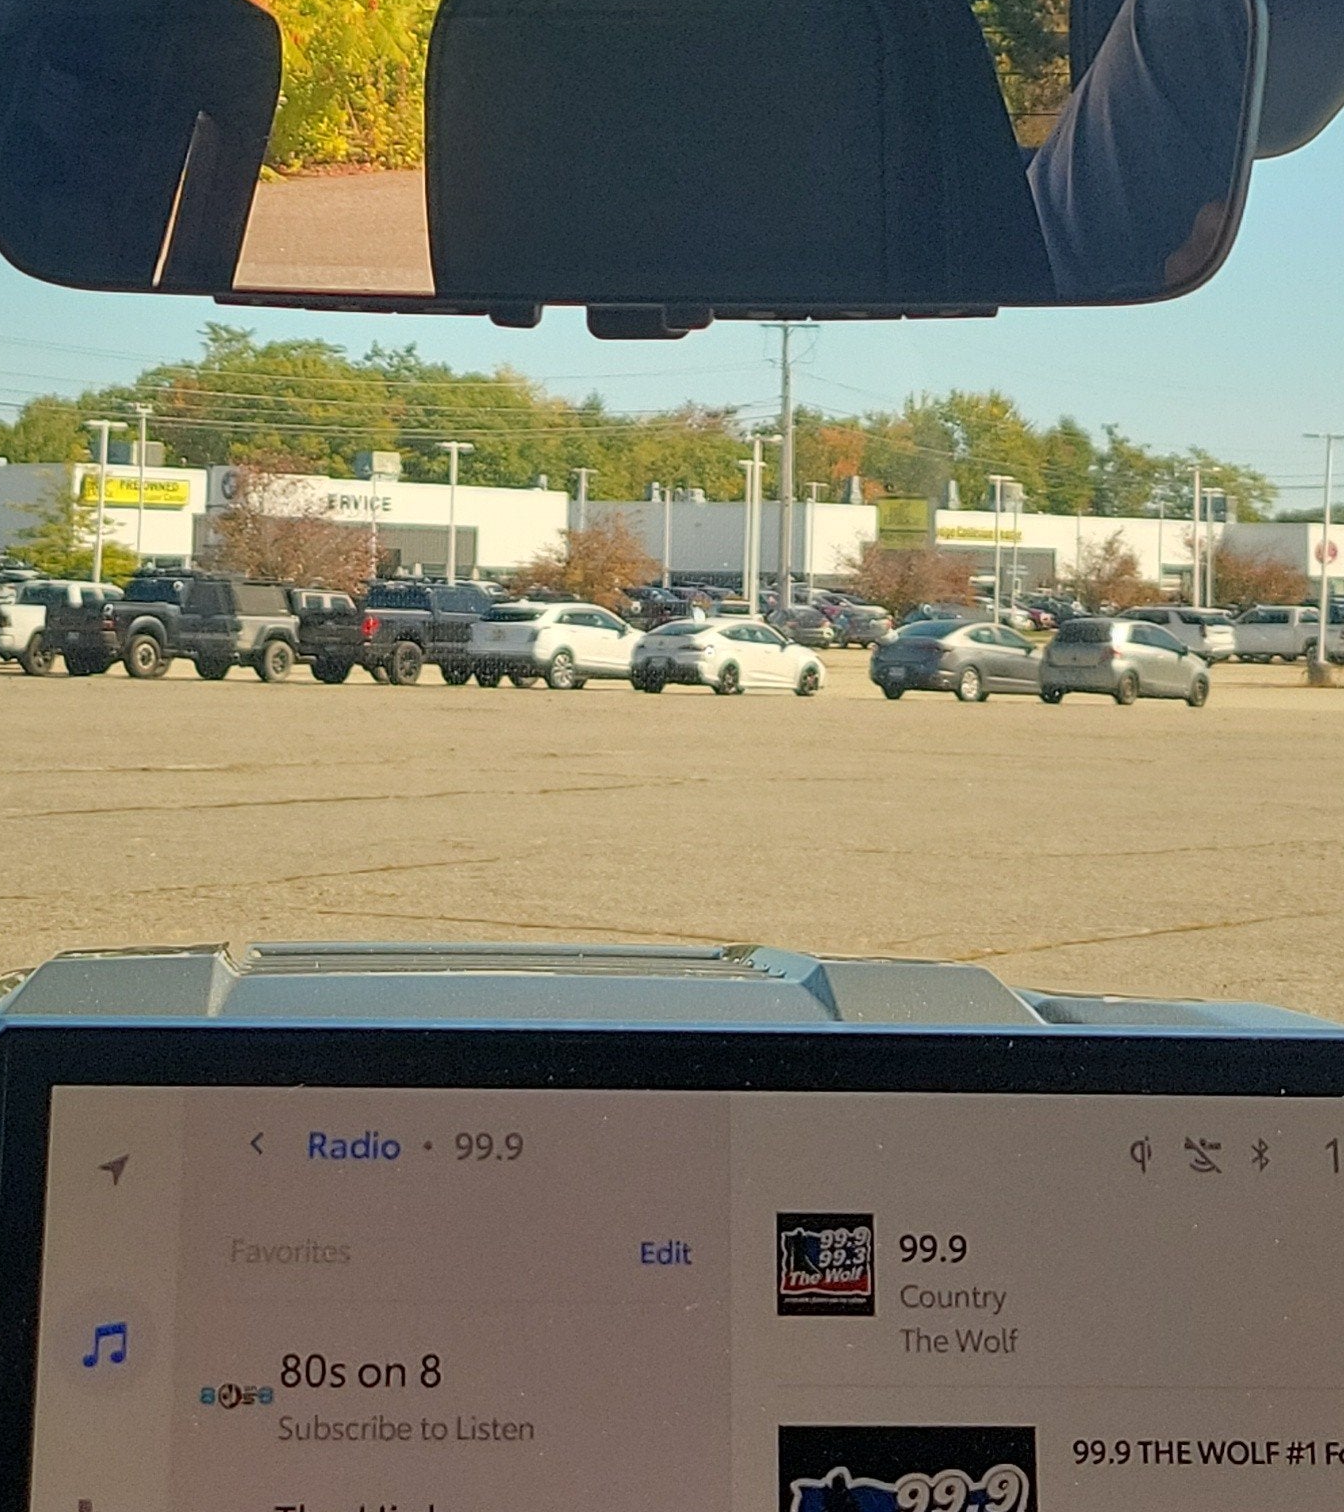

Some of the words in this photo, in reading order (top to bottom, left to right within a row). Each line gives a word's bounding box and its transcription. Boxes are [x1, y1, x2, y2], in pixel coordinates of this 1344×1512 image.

[307, 1131, 401, 1160] Radio
[456, 1131, 524, 1161] 99.9
[230, 1238, 352, 1265] Favorites
[640, 1241, 693, 1265] Edit
[899, 1234, 967, 1263] 99.9
[824, 1265, 864, 1283] Wolf
[900, 1284, 1006, 1315] Country
[899, 1327, 949, 1353] The
[955, 1327, 1019, 1354] Wolf
[279, 1353, 346, 1388] 80s
[358, 1361, 407, 1388] on
[420, 1353, 442, 1388] 8
[277, 1415, 412, 1442] Subscribe
[420, 1419, 449, 1442] to
[457, 1417, 535, 1442] Listen
[1072, 1440, 1131, 1465] 99.9
[1137, 1440, 1192, 1465] THE
[1197, 1440, 1280, 1465] WOLF
[1286, 1440, 1317, 1465] #1
